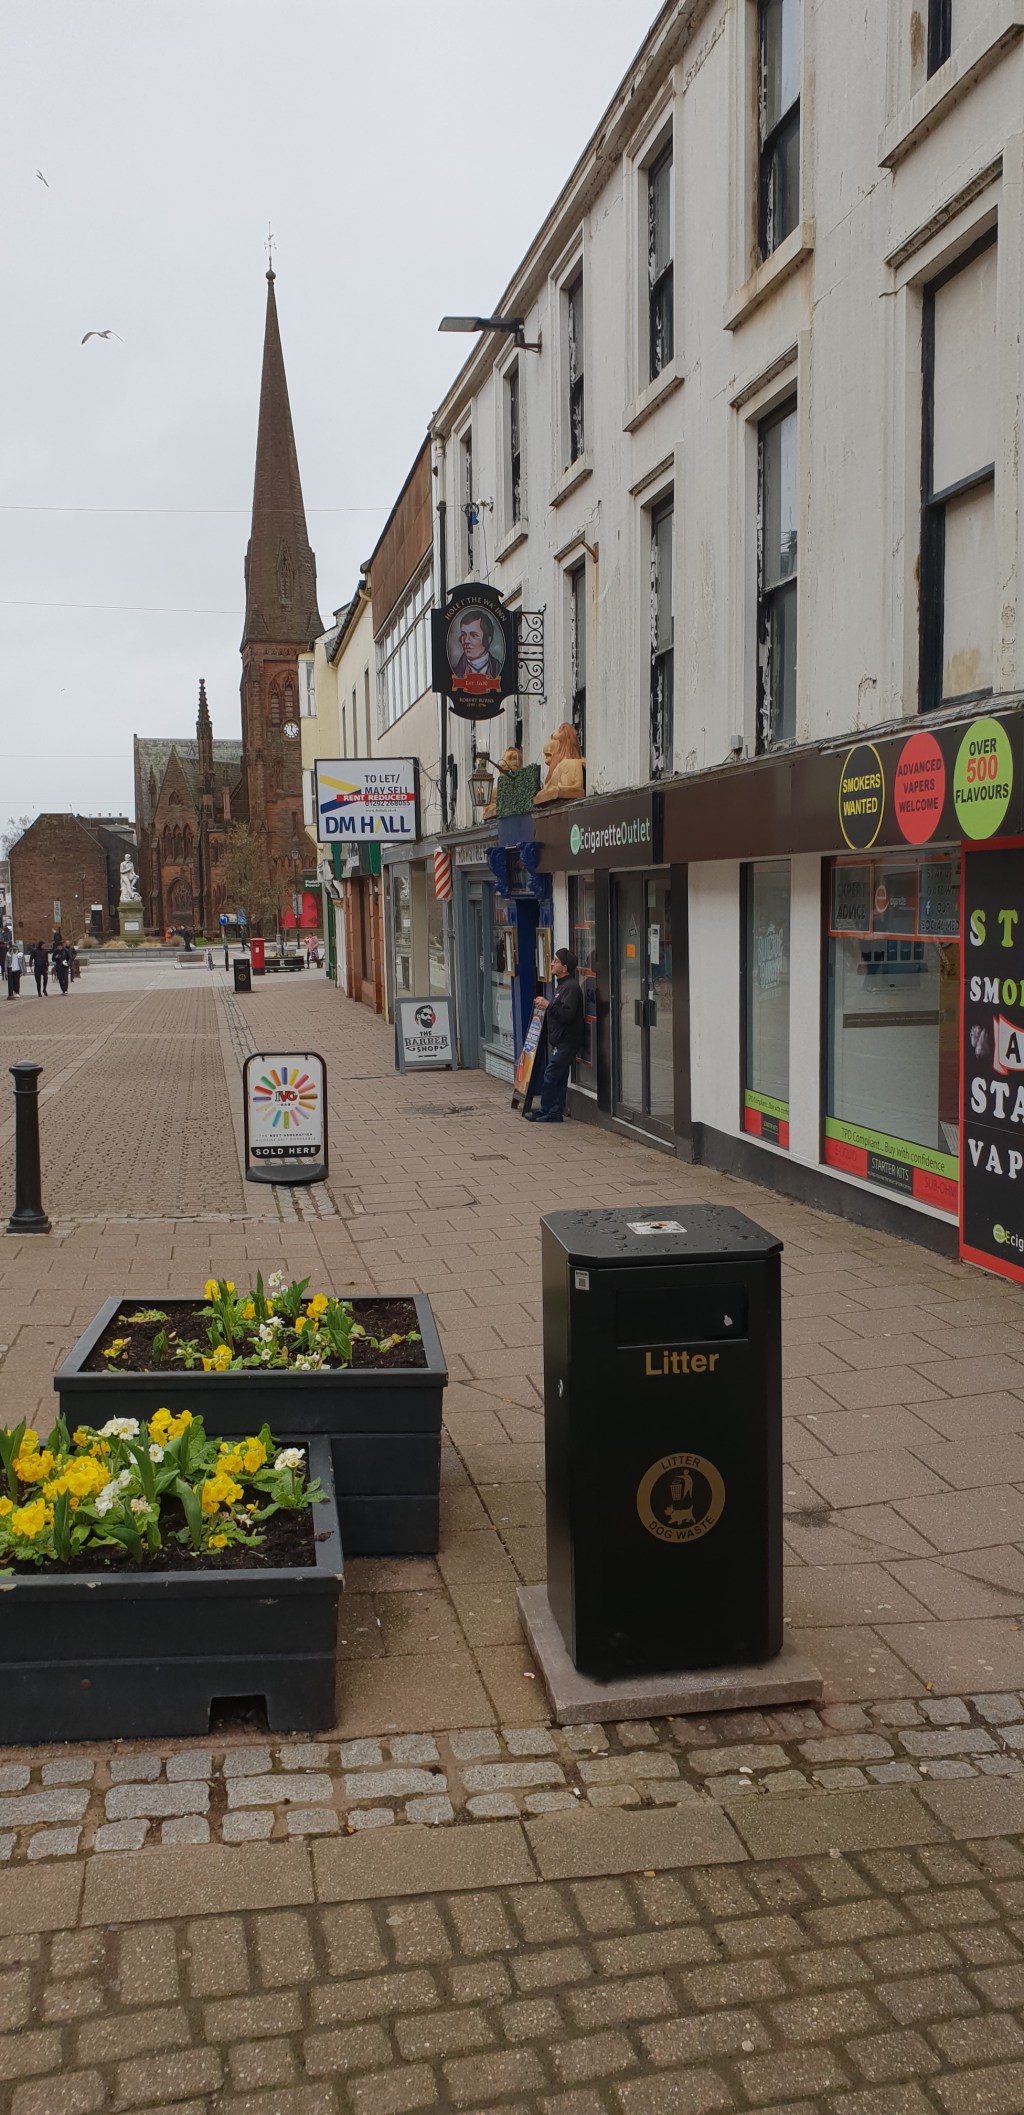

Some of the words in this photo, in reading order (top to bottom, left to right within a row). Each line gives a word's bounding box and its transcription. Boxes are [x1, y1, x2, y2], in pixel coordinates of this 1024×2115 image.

[444, 603, 461, 621] HOLE
[466, 597, 481, 605] THE
[496, 607, 507, 622] INN
[969, 737, 997, 756] OVER
[898, 758, 942, 776] ADVANCED
[966, 754, 999, 784] 500
[364, 774, 377, 783] TO
[379, 774, 401, 784] LET/
[842, 773, 881, 794] SMOKERS
[903, 778, 935, 794] VAPERS
[955, 783, 1009, 804] FLAVOURS
[843, 797, 878, 816] WANTED
[899, 797, 939, 814] WELCOME
[325, 816, 356, 834] DM
[360, 816, 411, 834] HALL
[580, 818, 651, 854] EcigaretteOutlet
[837, 903, 866, 921] ADVICE
[404, 1036, 448, 1047] BARBER
[417, 1045, 439, 1053] SHOP
[1005, 1031, 1022, 1064] A
[275, 1090, 298, 1102] IVG
[255, 1147, 284, 1156] SOLD
[288, 1146, 316, 1154] HERE
[841, 1127, 852, 1142] TPD
[884, 1143, 897, 1158] Buy
[896, 1146, 910, 1161] with
[910, 1150, 945, 1172] confidence
[871, 1157, 896, 1176] STARTER
[896, 1168, 910, 1181] KITS
[645, 1350, 720, 1376] Litter
[660, 1455, 701, 1470] LITTER
[648, 1520, 673, 1539] DOG
[676, 1515, 715, 1540] WASTE
